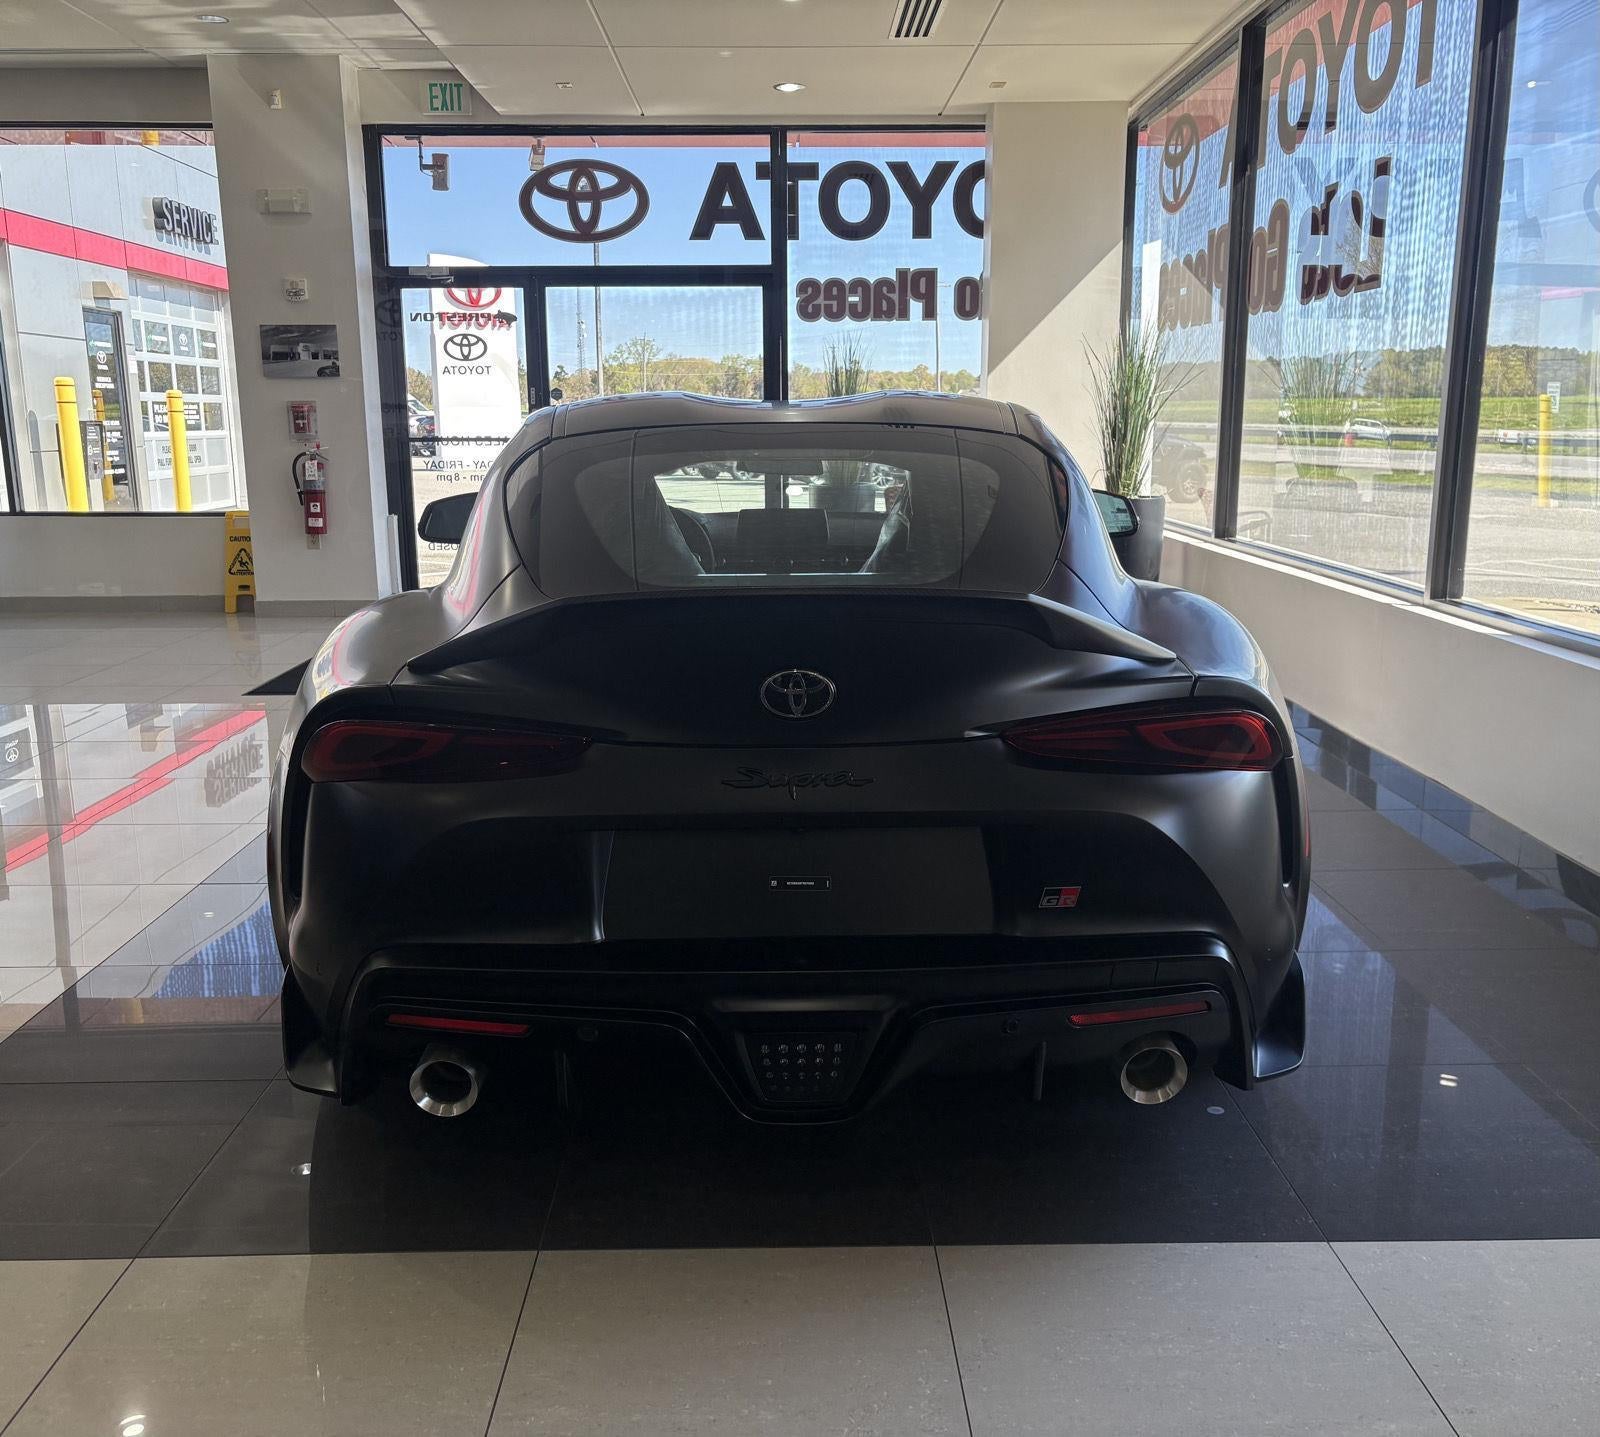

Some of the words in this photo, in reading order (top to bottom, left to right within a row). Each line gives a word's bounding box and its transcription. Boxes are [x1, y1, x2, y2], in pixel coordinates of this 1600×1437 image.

[429, 82, 463, 111] EXIT
[155, 197, 219, 245] SERVICE
[721, 766, 876, 801] Supra
